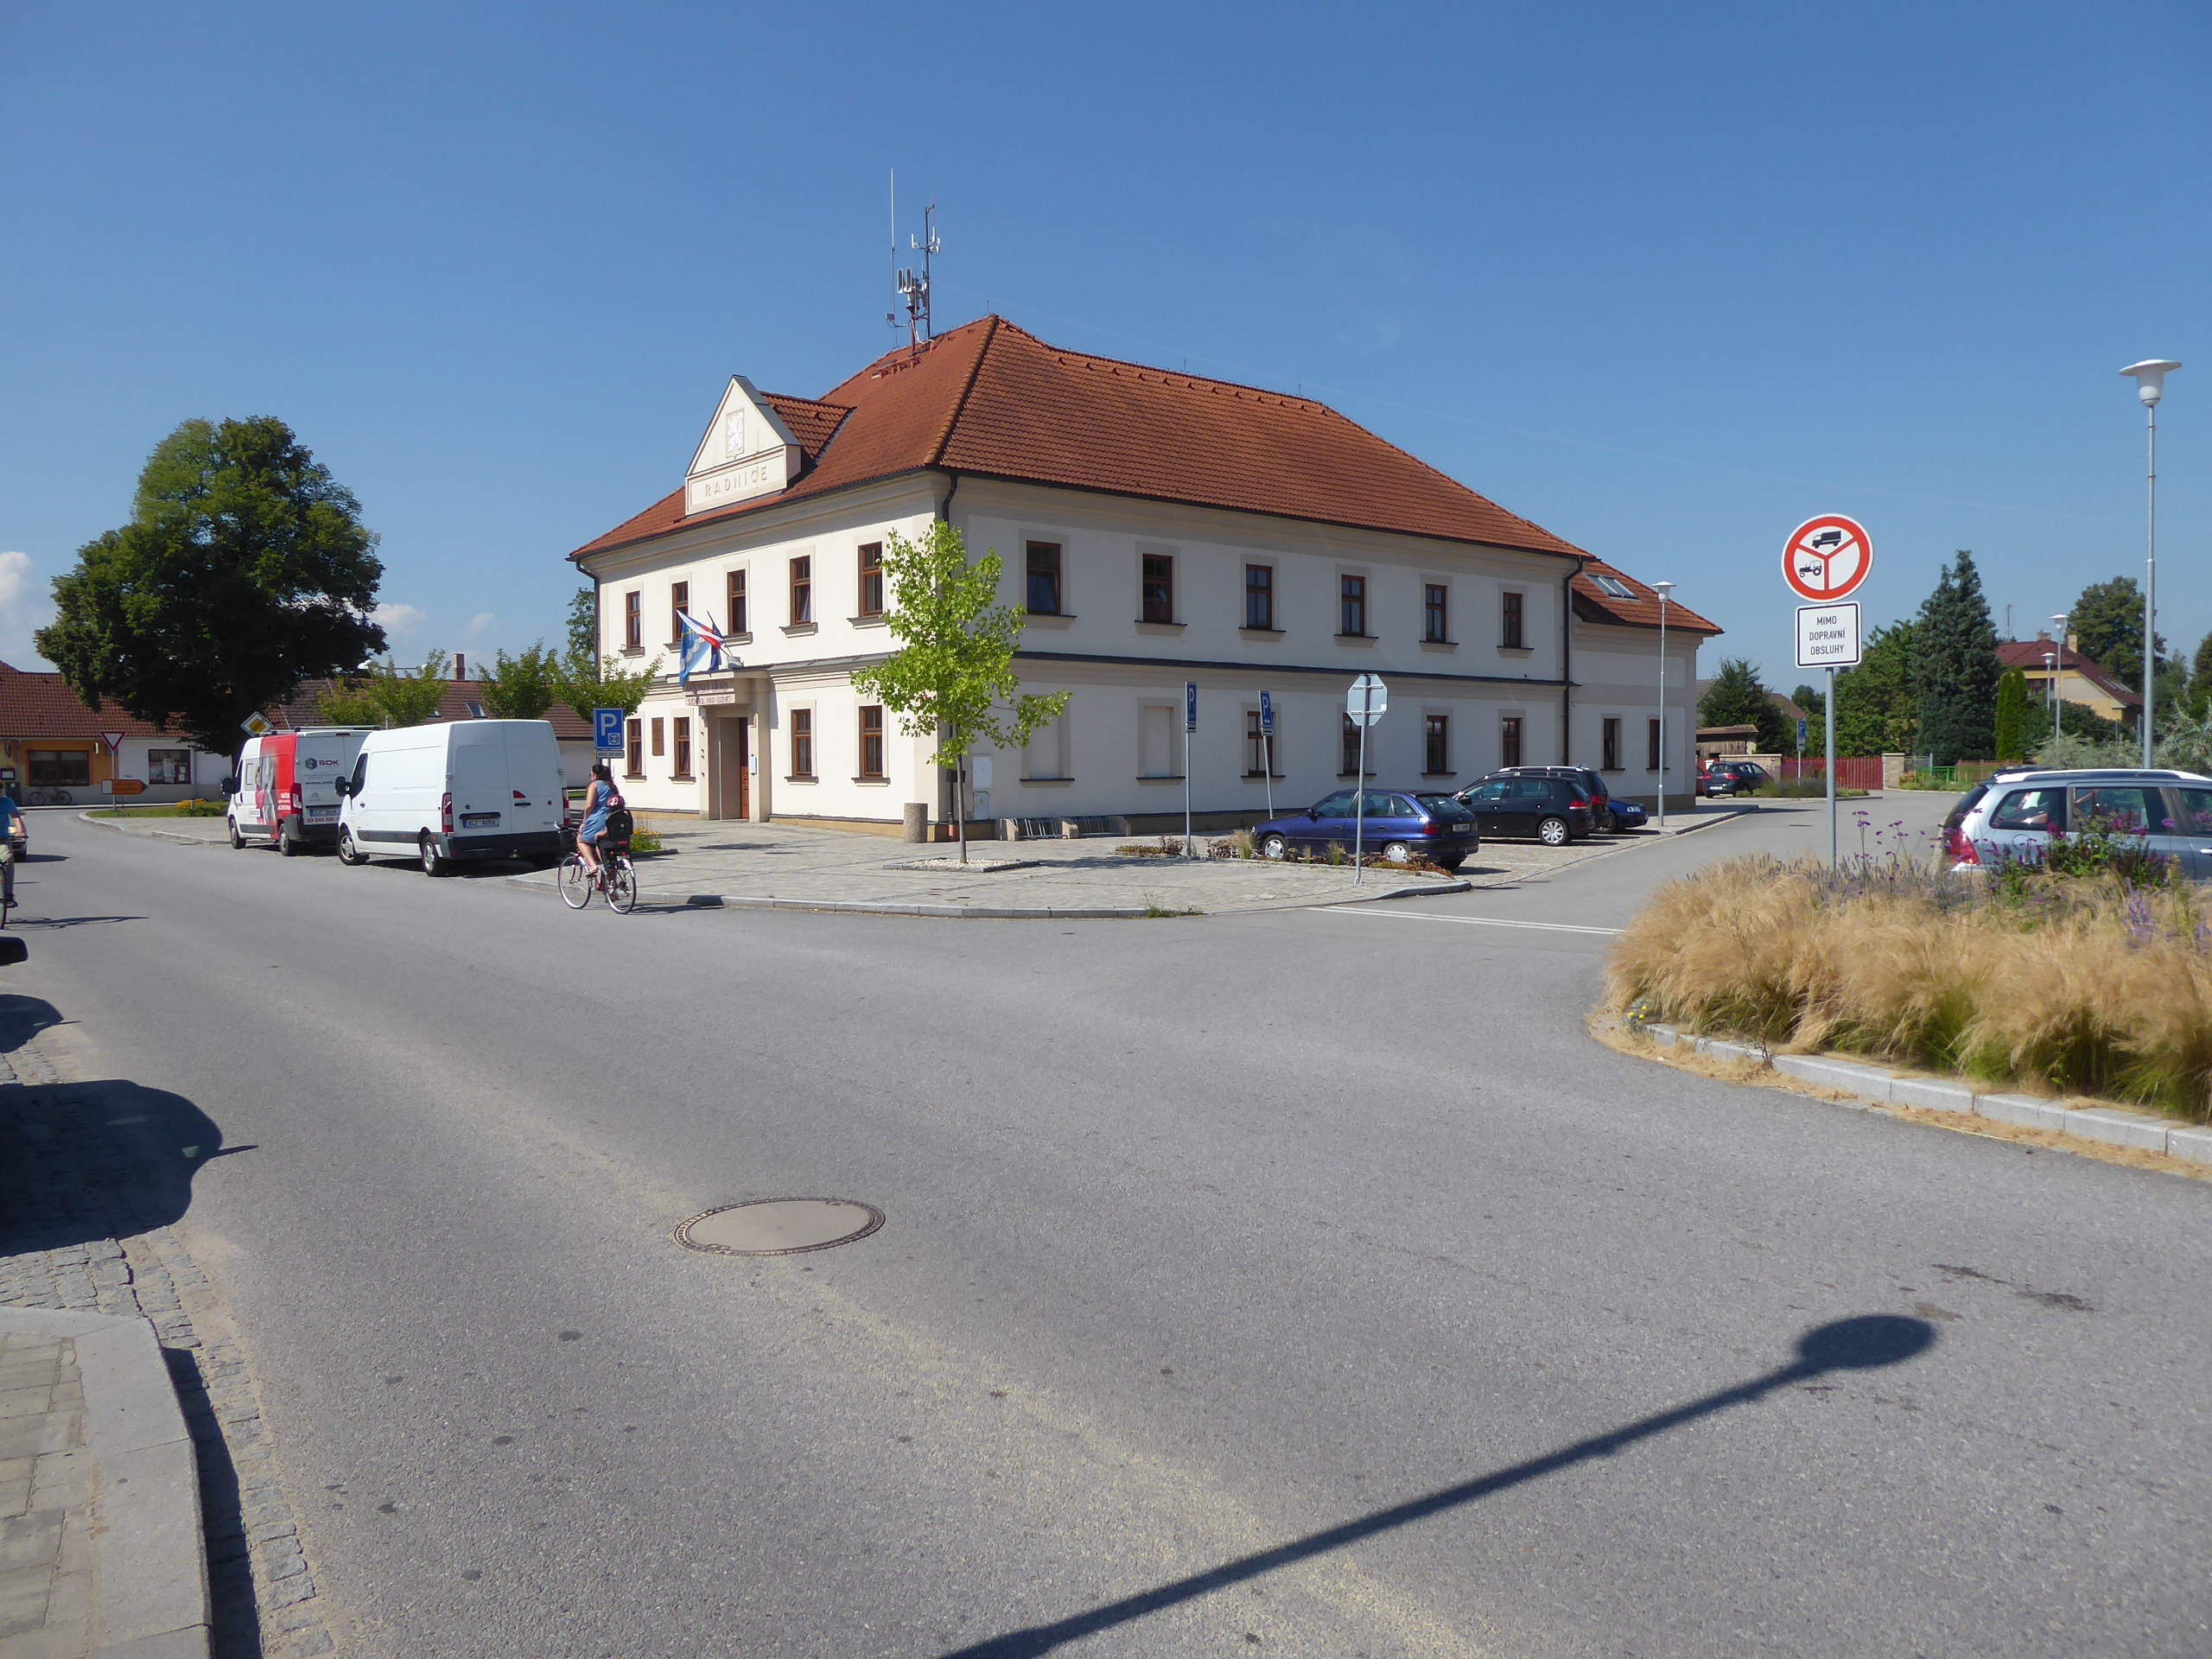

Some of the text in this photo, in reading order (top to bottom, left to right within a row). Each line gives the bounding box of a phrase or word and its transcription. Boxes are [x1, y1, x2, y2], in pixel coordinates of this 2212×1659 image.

[705, 466, 767, 497] RADNICE
[1816, 615, 1837, 626] MIMO
[1808, 627, 1846, 641] DOPRAVNÍ
[1810, 645, 1844, 655] OBSLUHY
[1188, 688, 1195, 709] P
[1262, 696, 1268, 715] P
[601, 713, 617, 736] P
